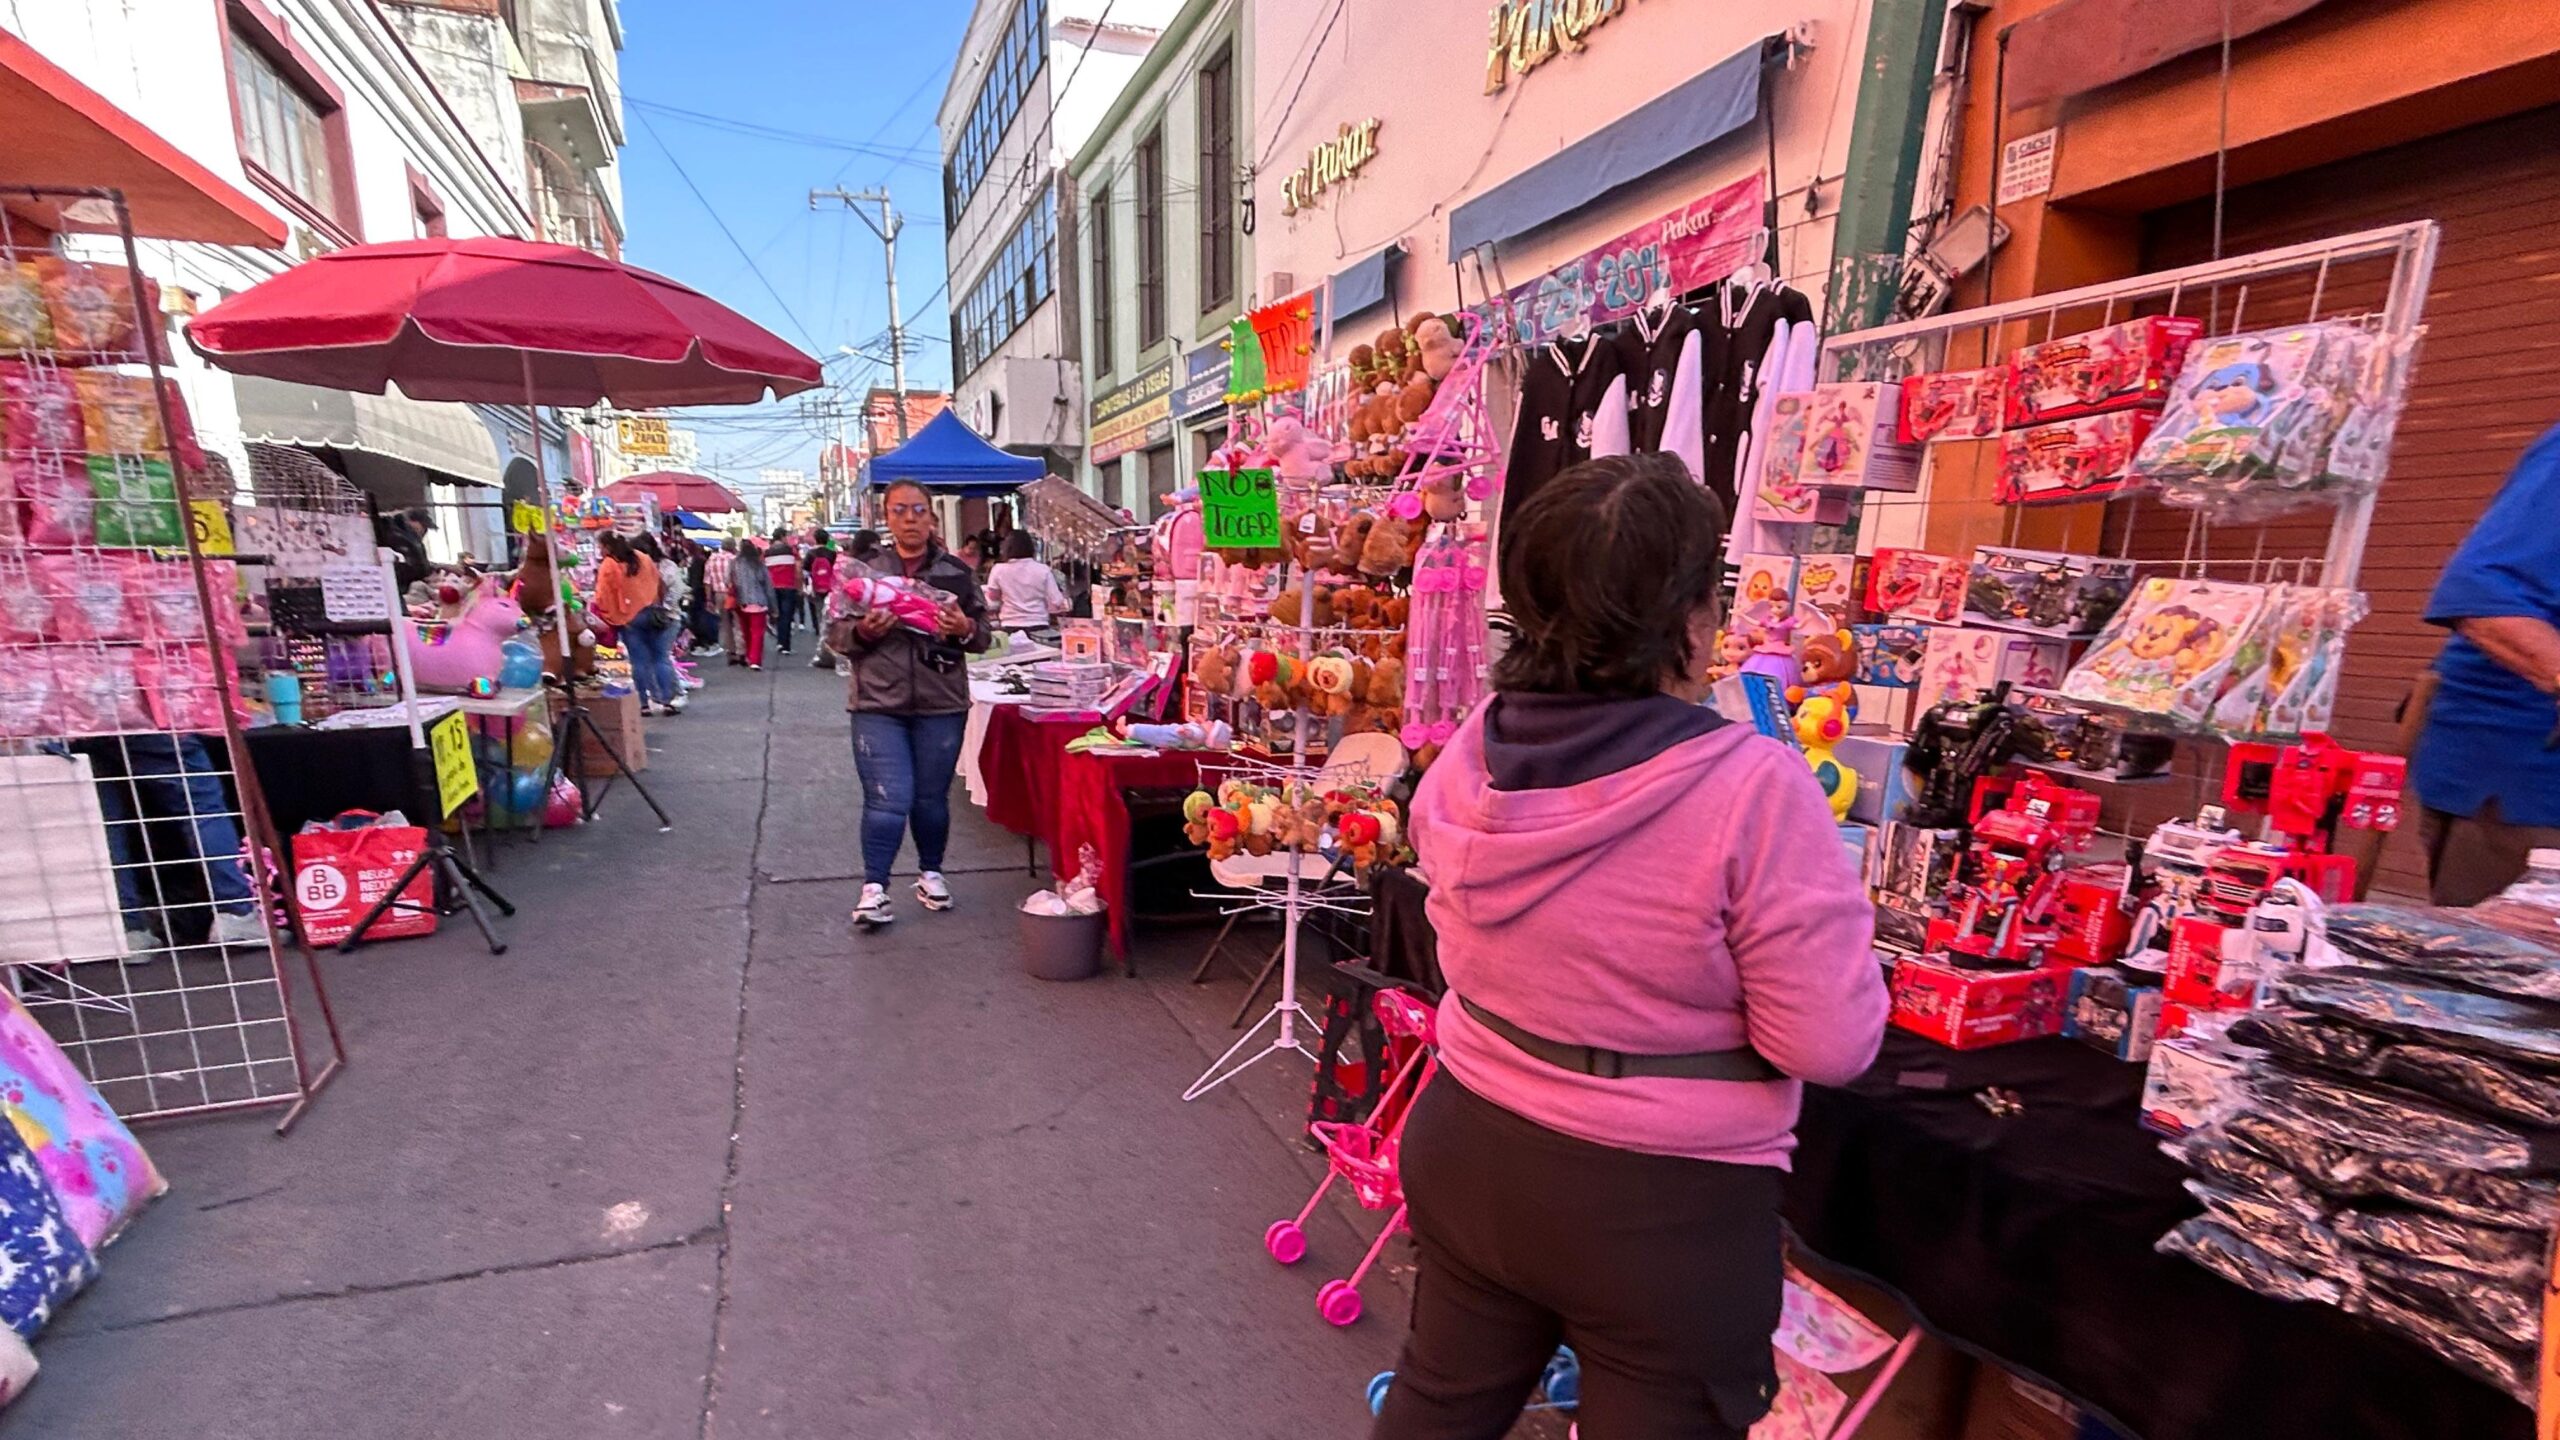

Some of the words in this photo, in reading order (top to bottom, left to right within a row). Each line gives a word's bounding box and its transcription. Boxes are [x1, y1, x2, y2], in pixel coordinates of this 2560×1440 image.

[1660, 205, 1715, 246] Pakar
[1202, 470, 1251, 497] NO
[312, 868, 328, 884] B
[306, 884, 339, 901] BB
